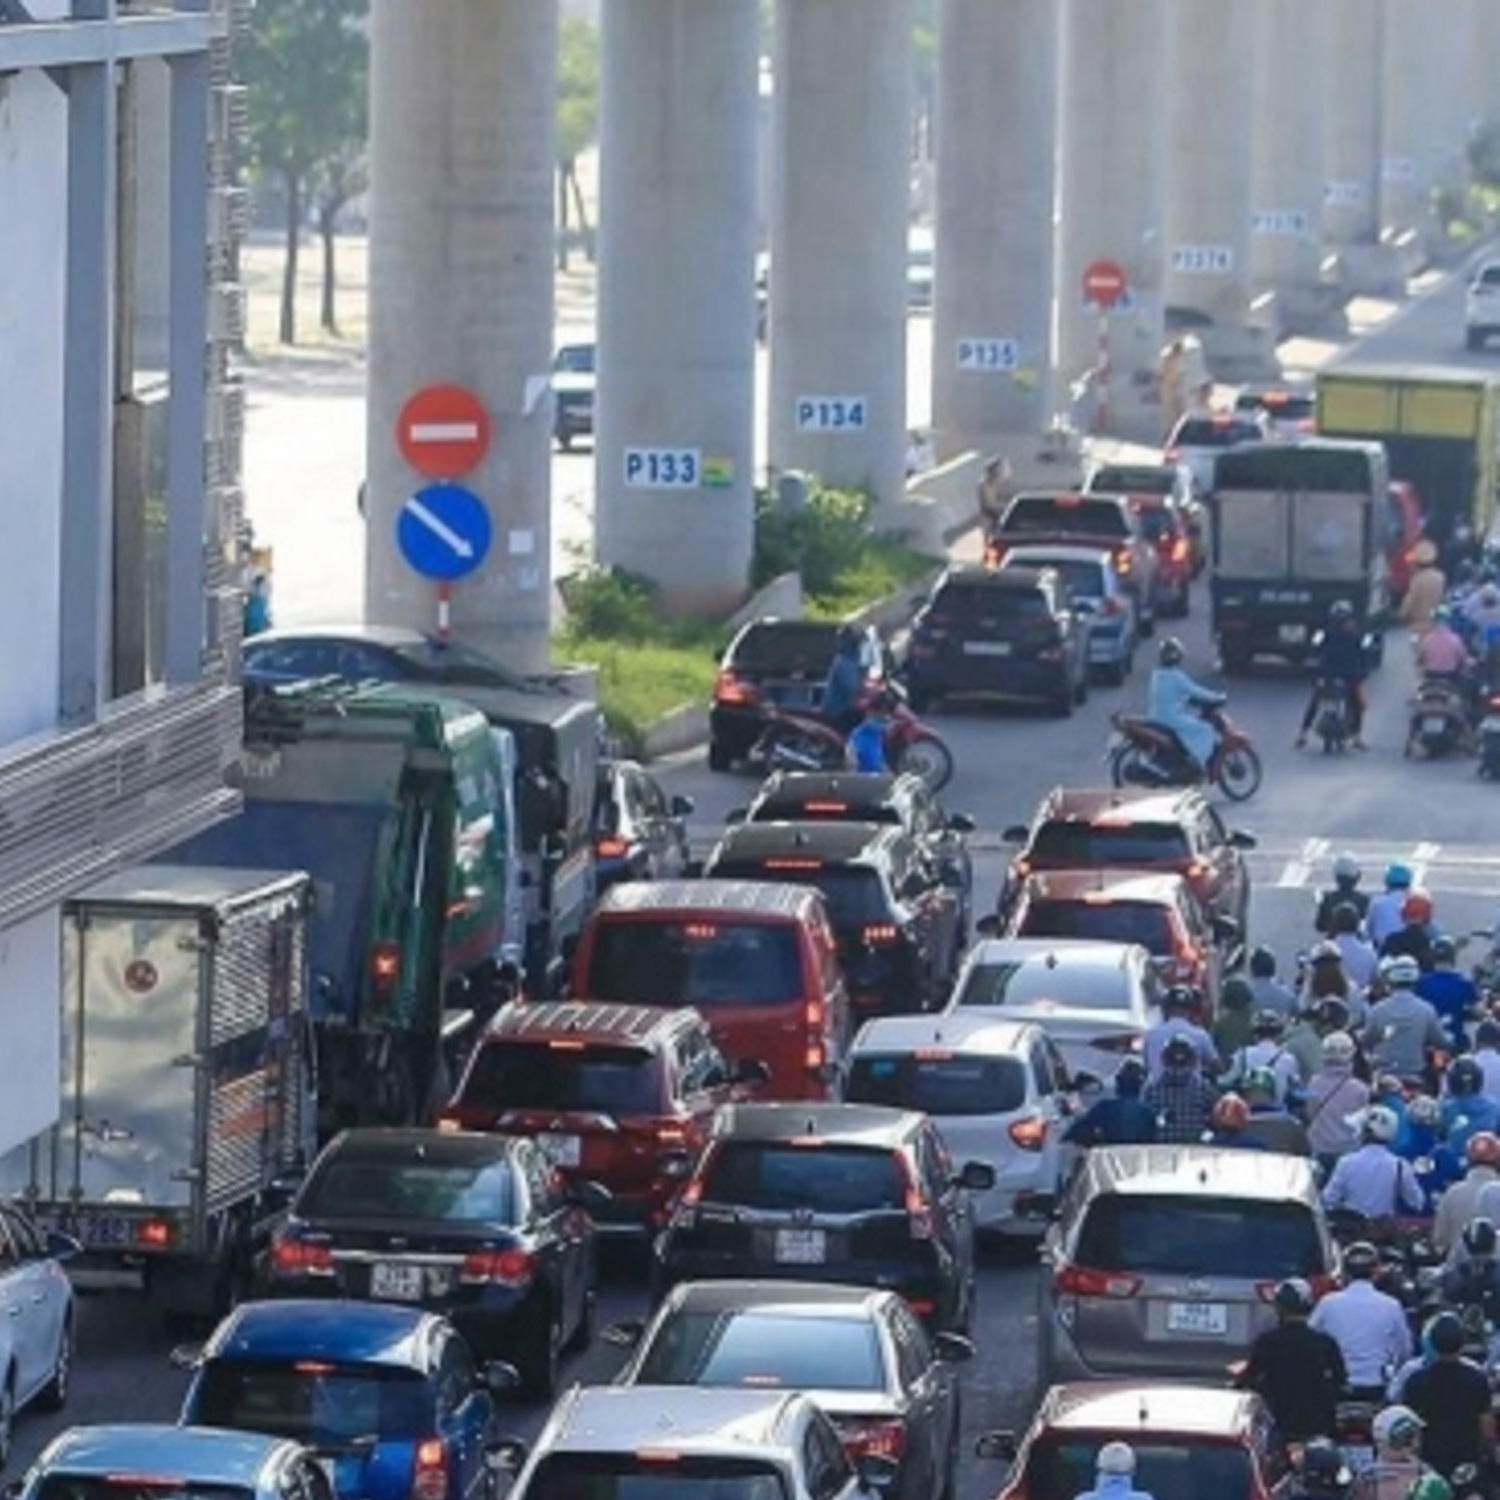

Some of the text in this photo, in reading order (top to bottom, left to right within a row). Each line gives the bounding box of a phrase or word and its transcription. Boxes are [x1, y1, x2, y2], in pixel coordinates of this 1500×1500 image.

[958, 342, 1016, 367] P135
[800, 402, 864, 428] P134
[627, 452, 696, 484] P133
